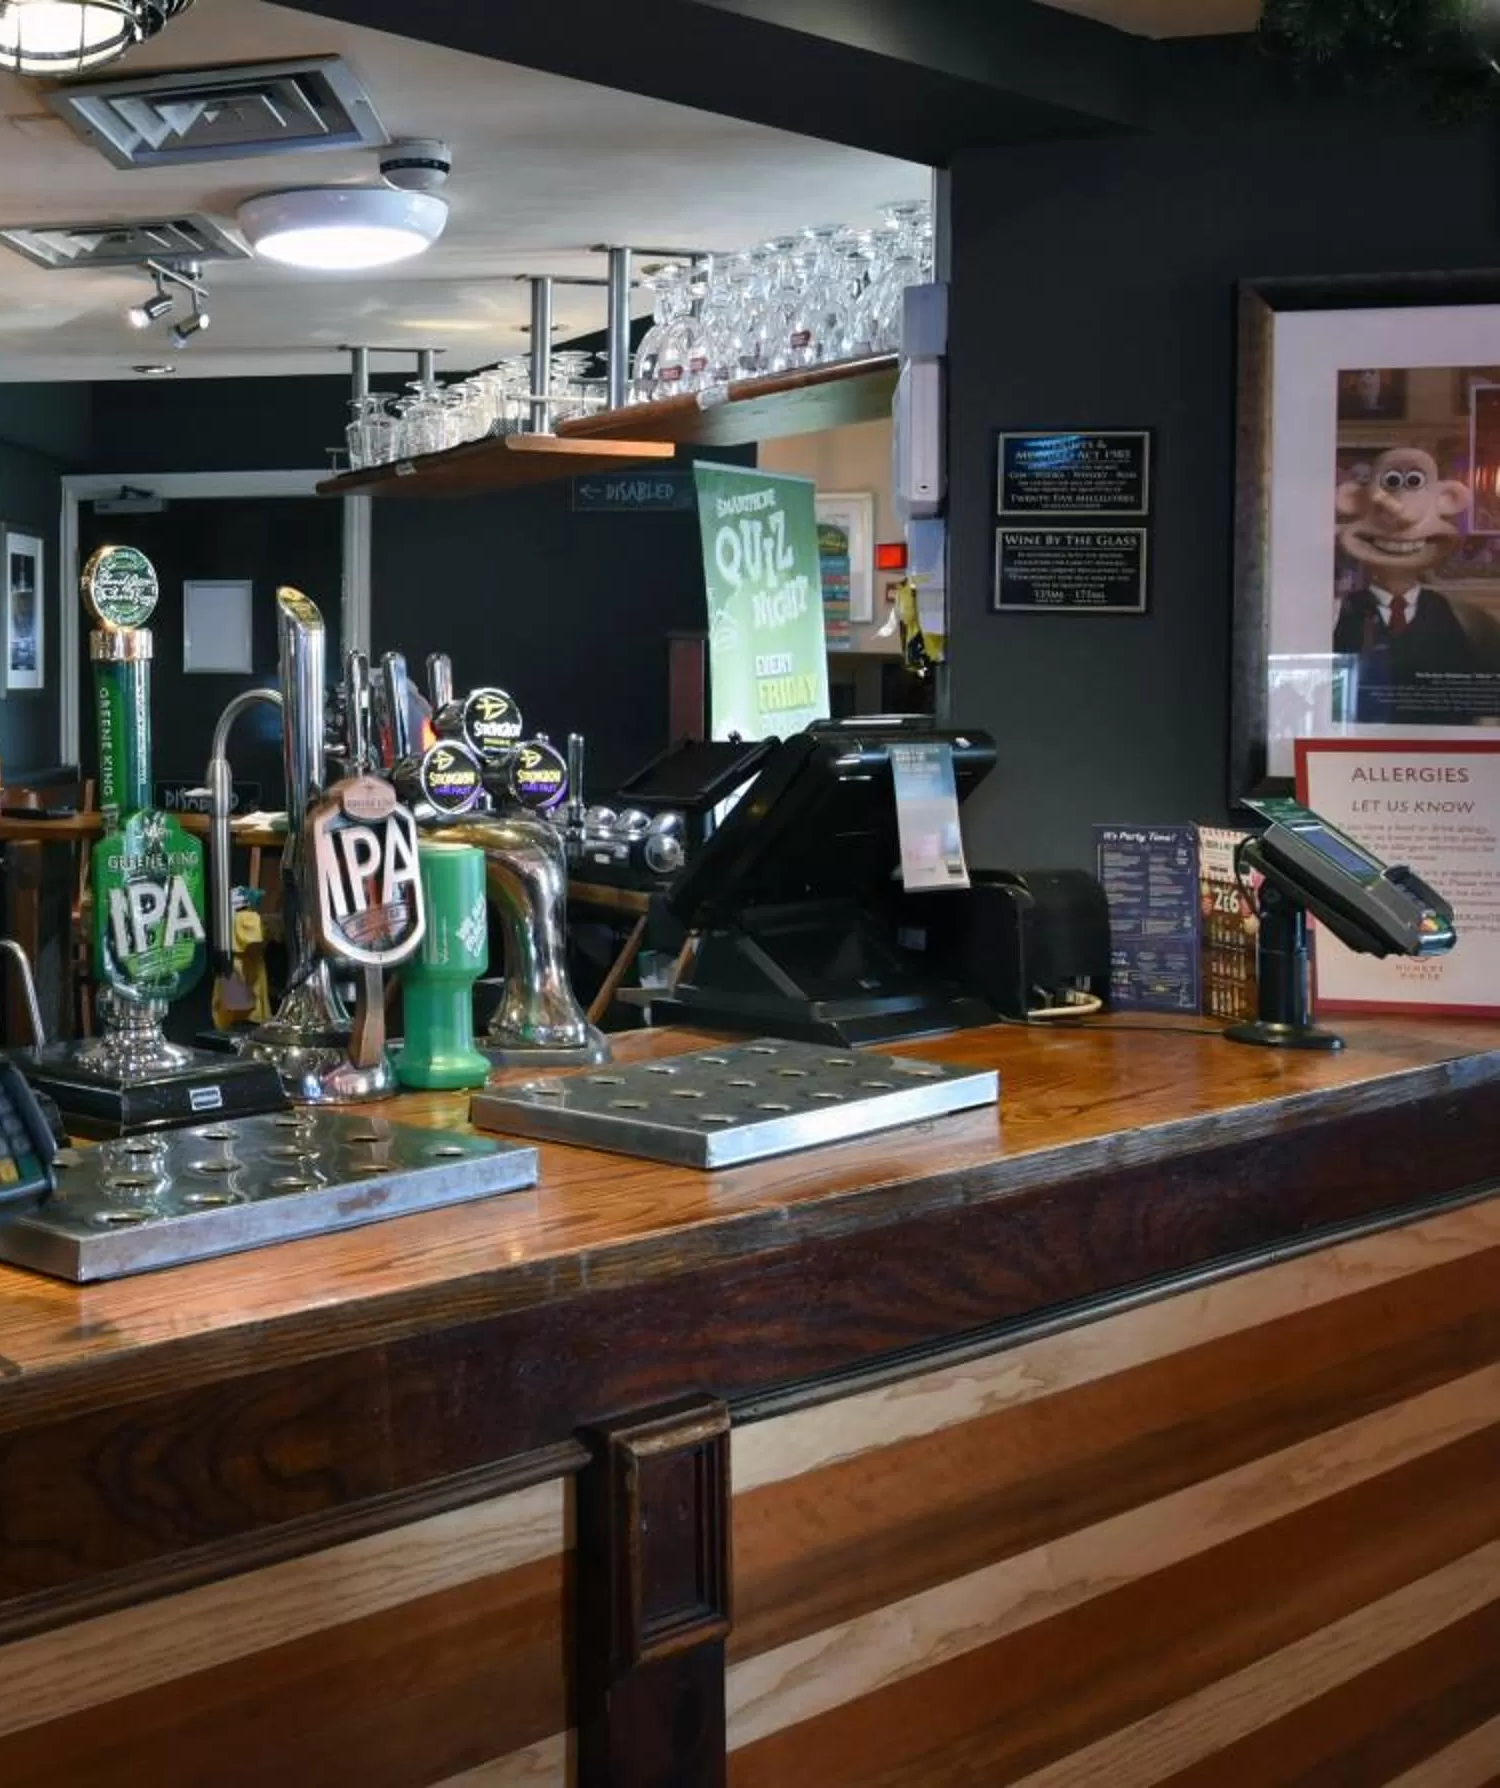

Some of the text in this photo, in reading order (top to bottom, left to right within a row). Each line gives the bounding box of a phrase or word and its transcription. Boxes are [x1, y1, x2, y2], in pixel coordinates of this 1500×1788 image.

[604, 480, 675, 503] DISABLED
[1004, 534, 1041, 546] WINE
[1066, 535, 1092, 546] THE
[1095, 534, 1138, 546] GLASS
[752, 575, 809, 630] NIGHT
[759, 673, 817, 712] FRIDAY
[103, 755, 114, 796] KING
[1352, 767, 1469, 783] ALLERGIES
[1352, 800, 1476, 814] LET US KNOW
[1120, 831, 1146, 843] Party
[168, 852, 199, 865] KING
[323, 815, 420, 917] IPA
[108, 875, 206, 959] IPA
